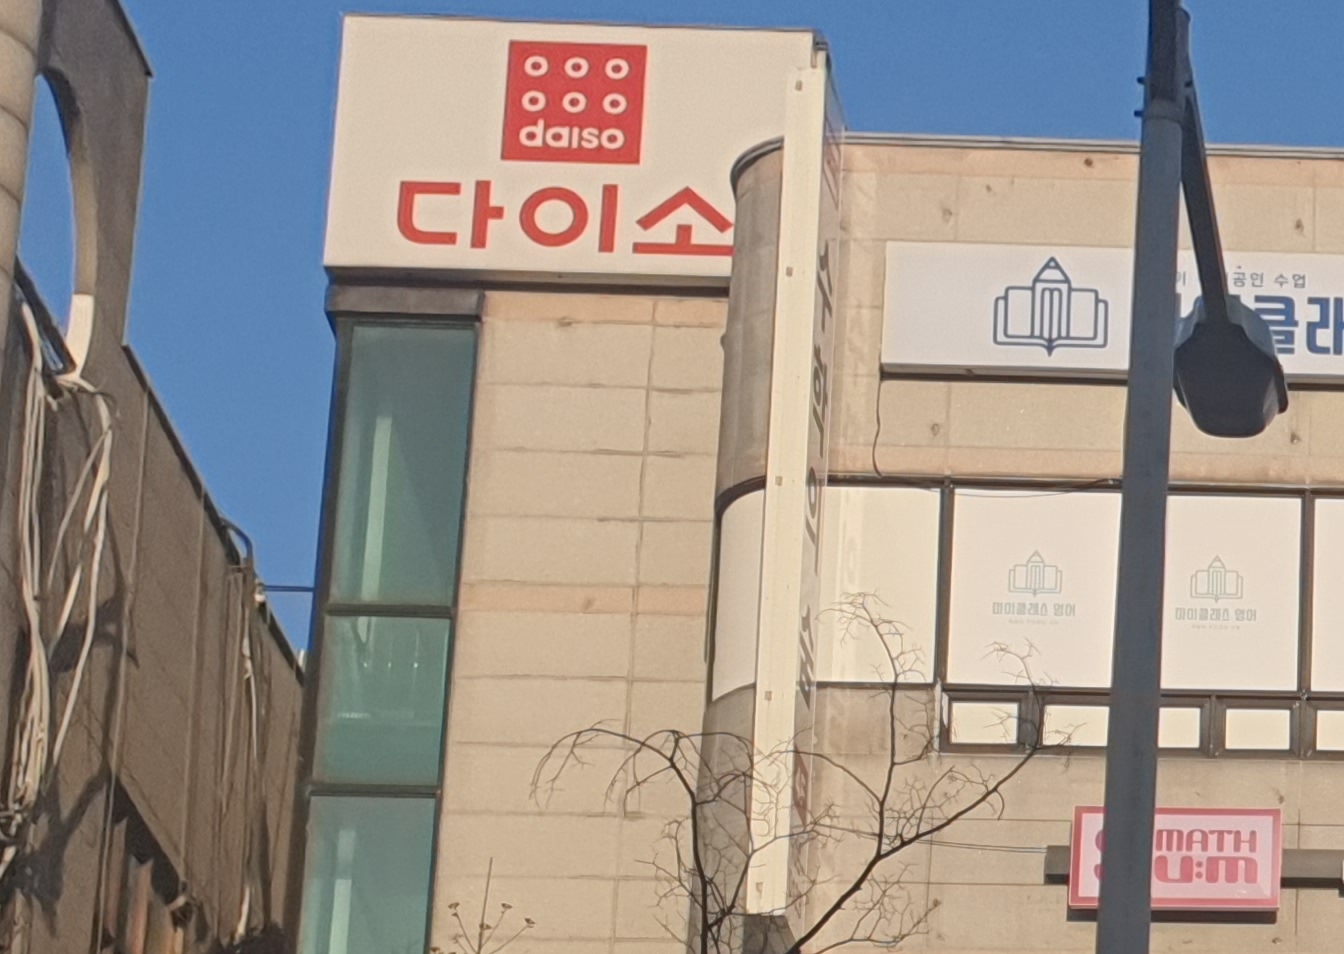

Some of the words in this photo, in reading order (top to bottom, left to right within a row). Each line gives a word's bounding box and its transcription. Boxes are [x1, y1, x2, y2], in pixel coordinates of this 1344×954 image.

[518, 119, 626, 151] daiso
[396, 178, 735, 257] 다이소
[1225, 271, 1265, 288] 공인
[1273, 272, 1307, 289] 수업
